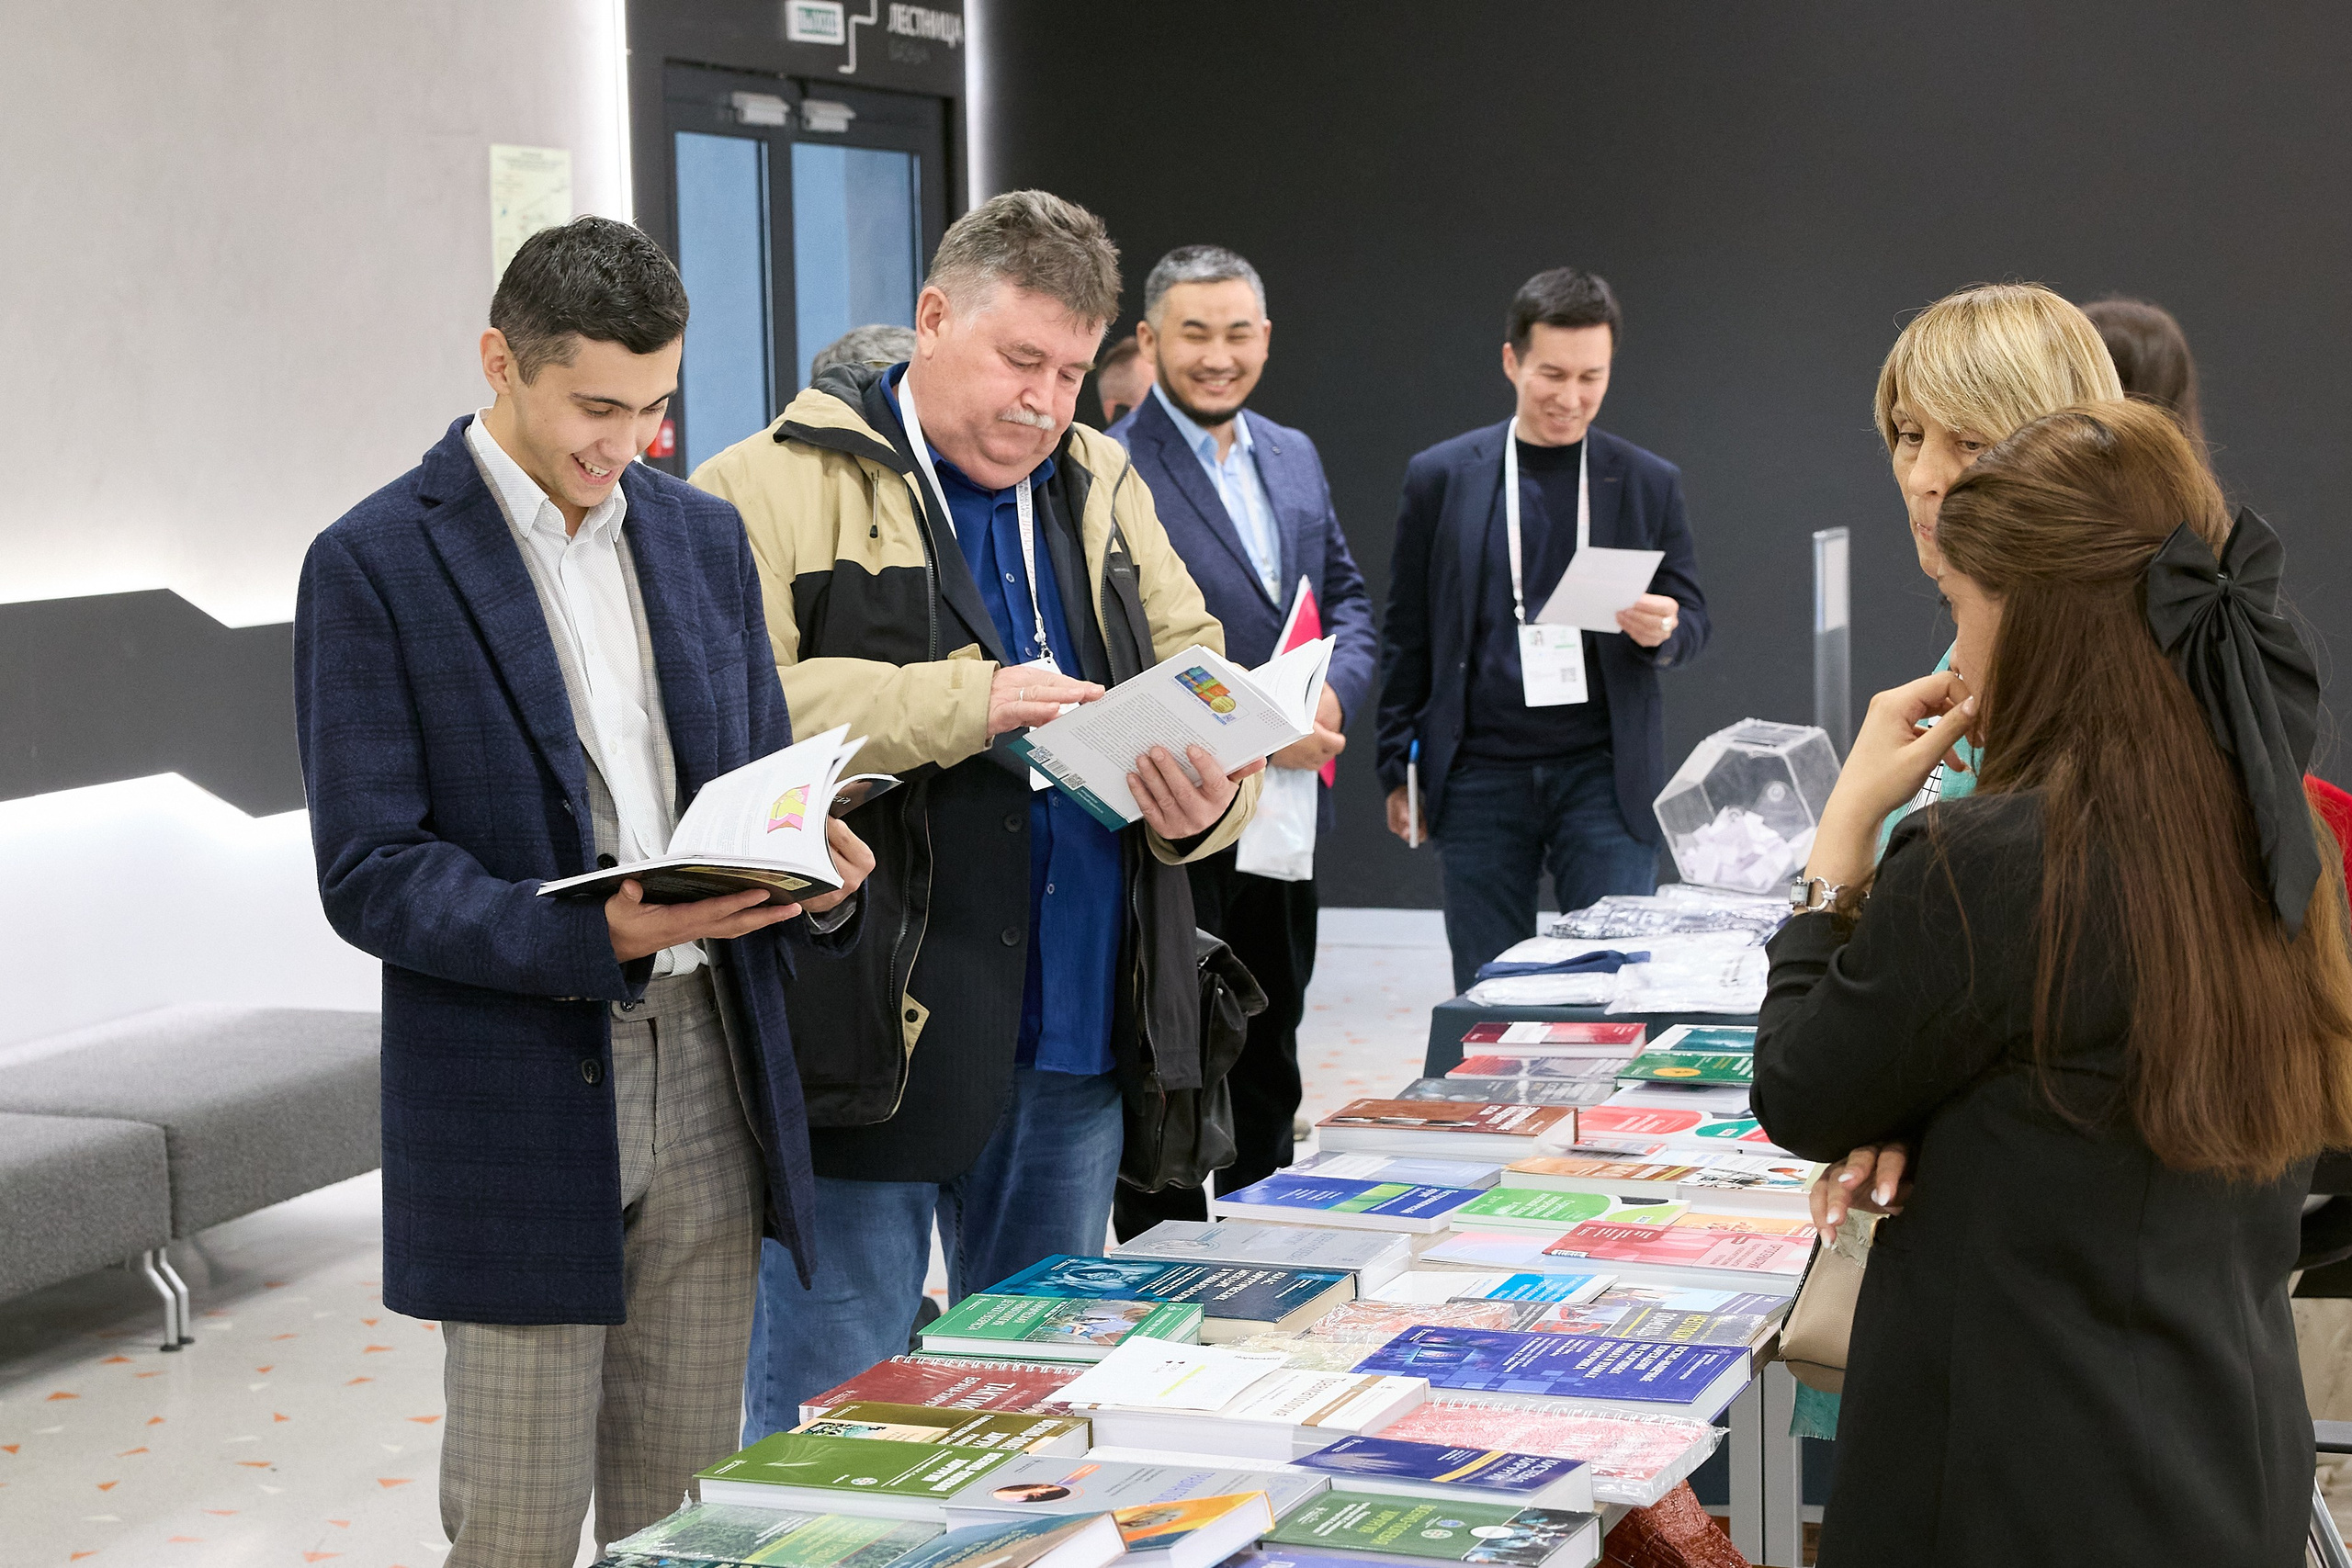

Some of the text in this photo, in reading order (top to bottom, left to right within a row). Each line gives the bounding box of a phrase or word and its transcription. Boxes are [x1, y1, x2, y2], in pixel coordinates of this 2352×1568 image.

[1161, 1270, 1232, 1303] ТРАВМАТОЛОГИИ
[1206, 1269, 1275, 1301] ХИРУРГИЧЕСКИХ
[1208, 1269, 1257, 1288] МЕТОДИК
[1254, 1270, 1294, 1286] АТЛАС
[982, 1298, 1019, 1315] ДЕТСКОГО
[987, 1299, 1035, 1325] ТРАВМАТОЛОГИЯ
[1009, 1299, 1054, 1324] КЛИНИЧЕСКАЯ
[961, 1314, 998, 1331] ВОЗРАСТА
[1632, 1311, 1679, 1337] ПОМОЩЬ
[1570, 1340, 1618, 1371] ПОЗВОНОЧНИКА
[1604, 1341, 1636, 1359] ТРАВМАХ
[1605, 1343, 1655, 1375] ПРИ СПОРТИВНЫХ
[1629, 1343, 1672, 1371] ПОВРЕЖДЕНИЯ
[1579, 1360, 1613, 1379] ТРАВМАХ
[1636, 1345, 1691, 1382] КОСТНО-МЫШЕЧНЫЕ
[915, 1375, 985, 1408] ВРАЧА-ХИРУР
[944, 1380, 1019, 1412] ТАКТИК
[1260, 1375, 1349, 1417] Травматология
[948, 1432, 984, 1446] РУКОВОД
[965, 1430, 1014, 1448] ХИРУР
[992, 1418, 1067, 1450] ВОЕННО-ПОЛЕ
[1543, 1431, 1604, 1460] ТАКТИ
[917, 1458, 973, 1483] ХИРУРГИЯ
[925, 1451, 1007, 1492] ВОЕННО-ПОЛЕВАЯ
[1478, 1455, 1545, 1481] ХИРУРГИЯ
[1500, 1458, 1566, 1483] КИСТЕВАЯ
[1352, 1509, 1403, 1534] ХИРУРГИЯ
[1366, 1503, 1439, 1545] ВОЕННО-ПОЛЕВАЯ
